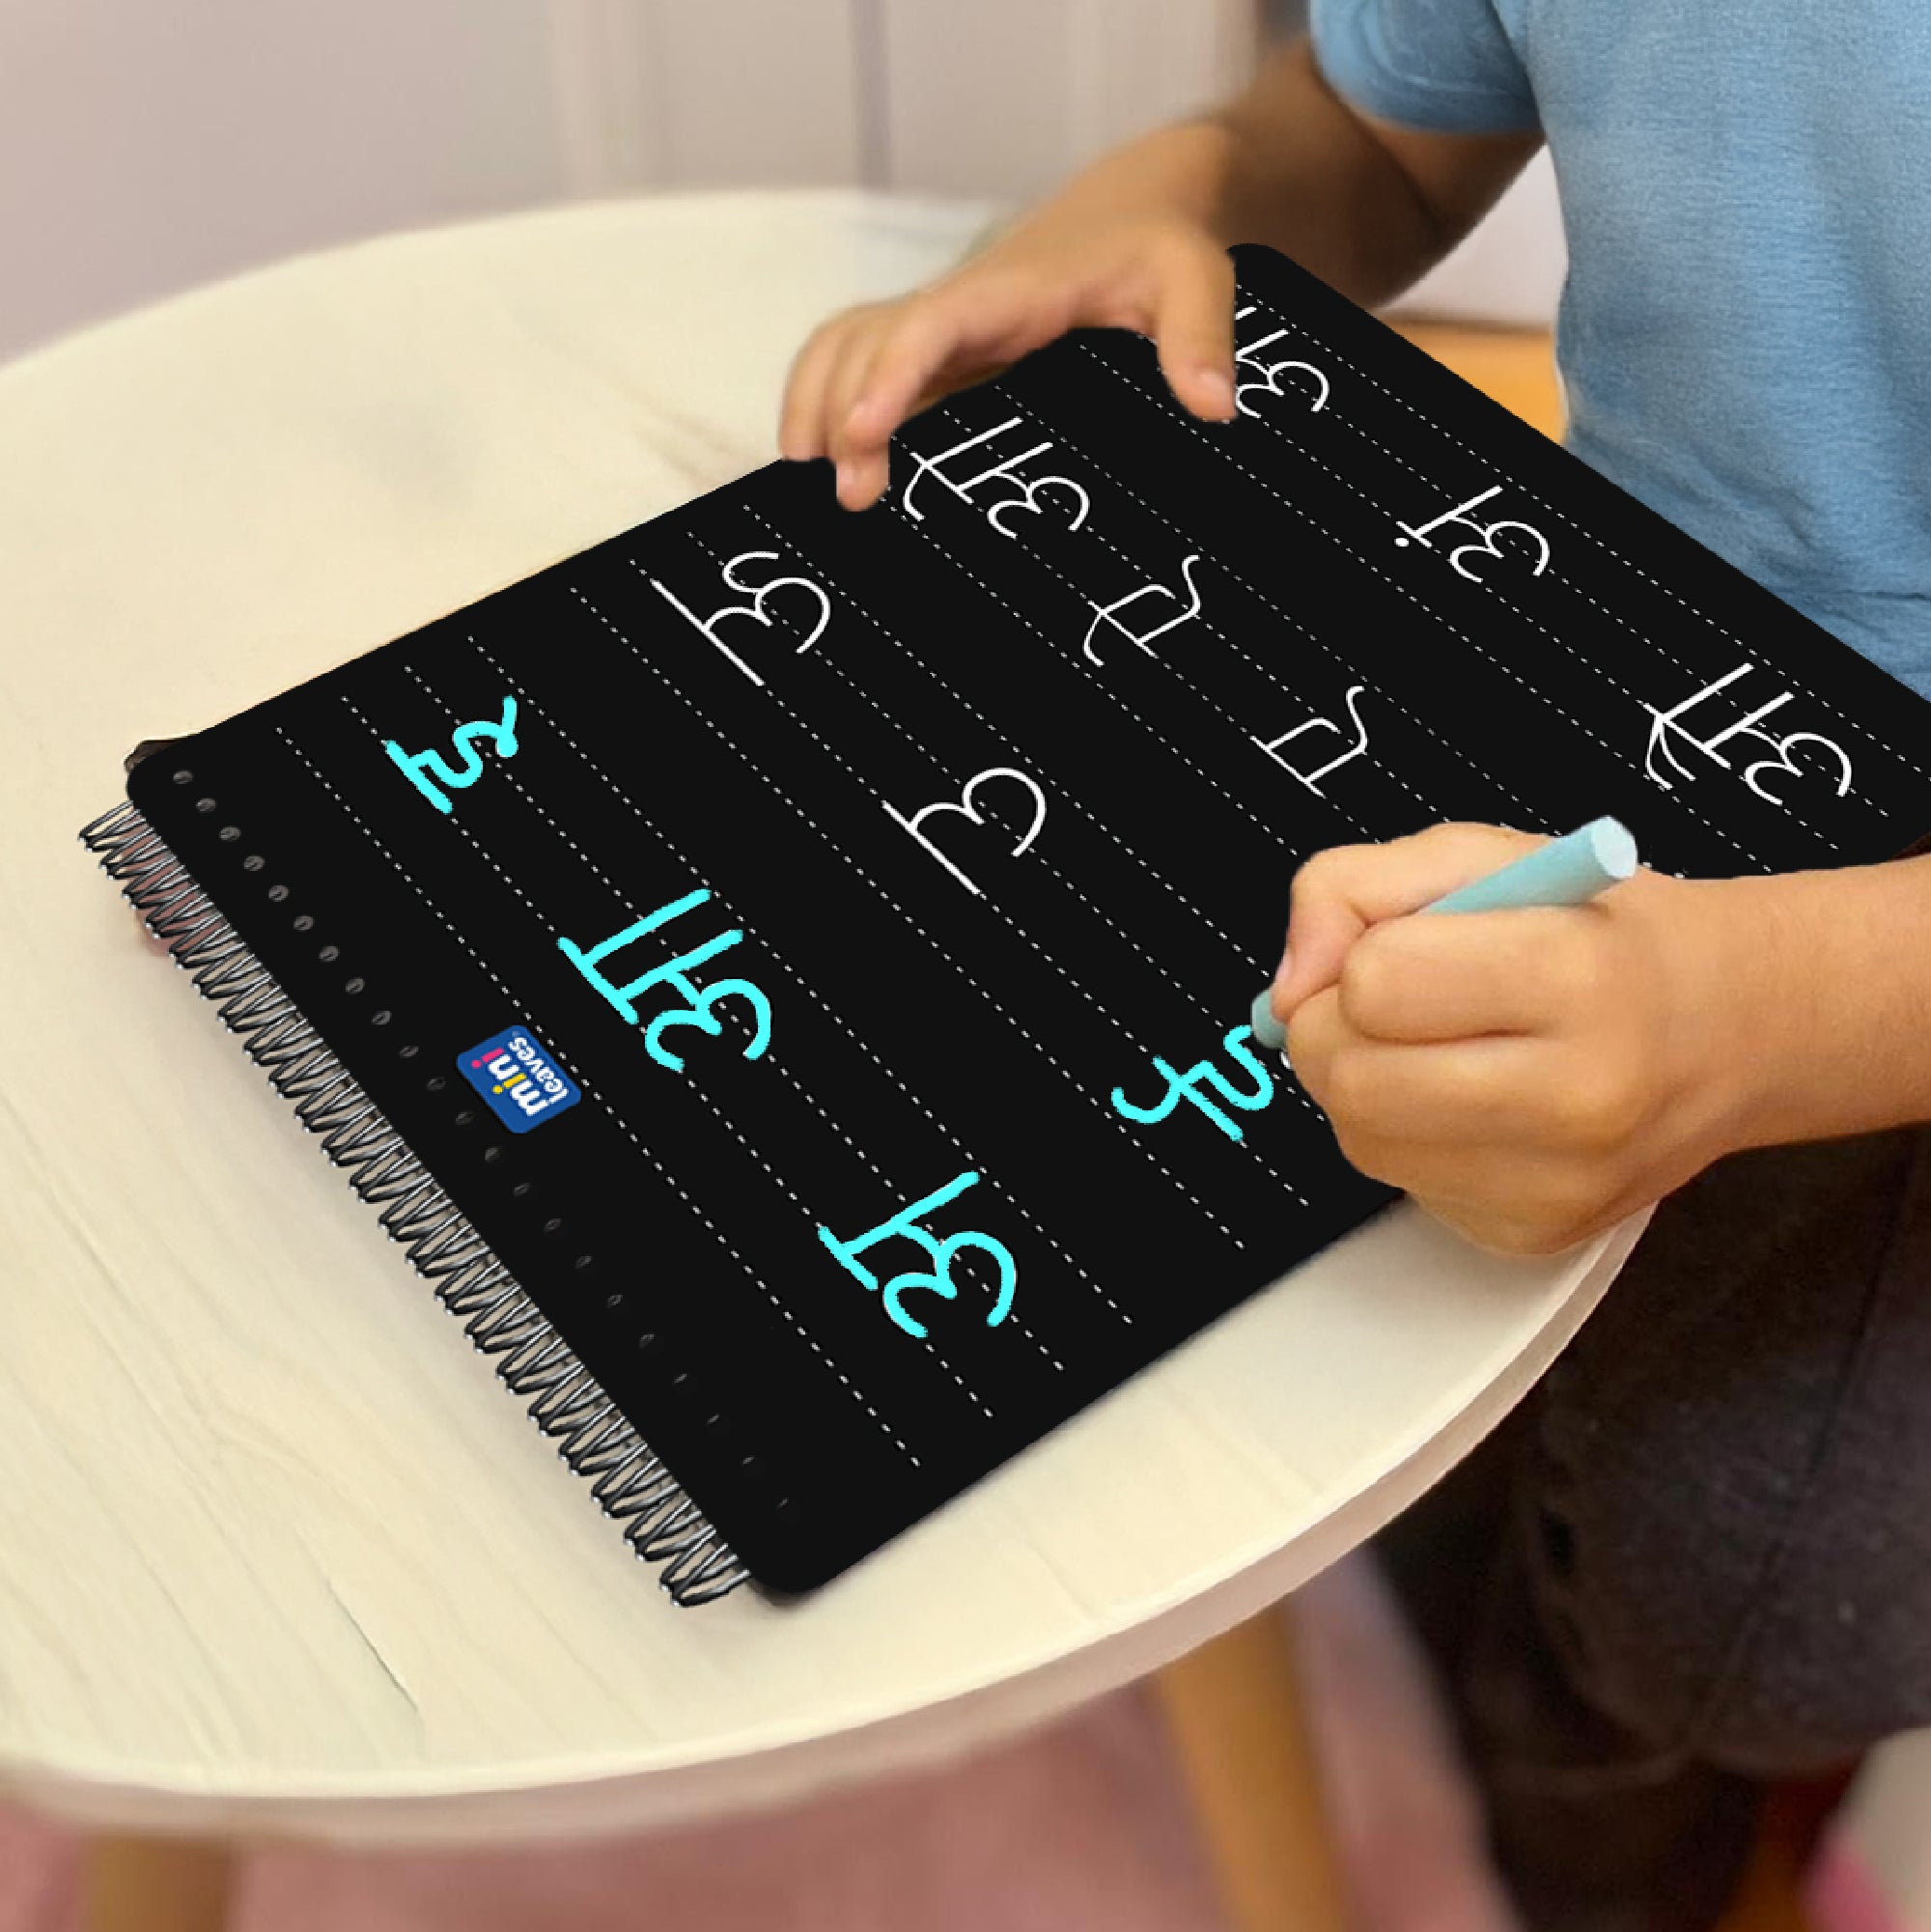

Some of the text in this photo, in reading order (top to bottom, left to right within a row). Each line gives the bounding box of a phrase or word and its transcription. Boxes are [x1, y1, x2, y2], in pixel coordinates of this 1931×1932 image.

[1394, 486, 1551, 583] अं
[651, 550, 831, 686] ऊ
[903, 417, 1368, 798] ए ऐ ओ
[1642, 662, 1852, 805] औ
[882, 768, 1046, 895] उ
[386, 695, 1016, 1338] अ आ इ
[470, 1047, 548, 1117] mini
[508, 1037, 569, 1105] leaves
